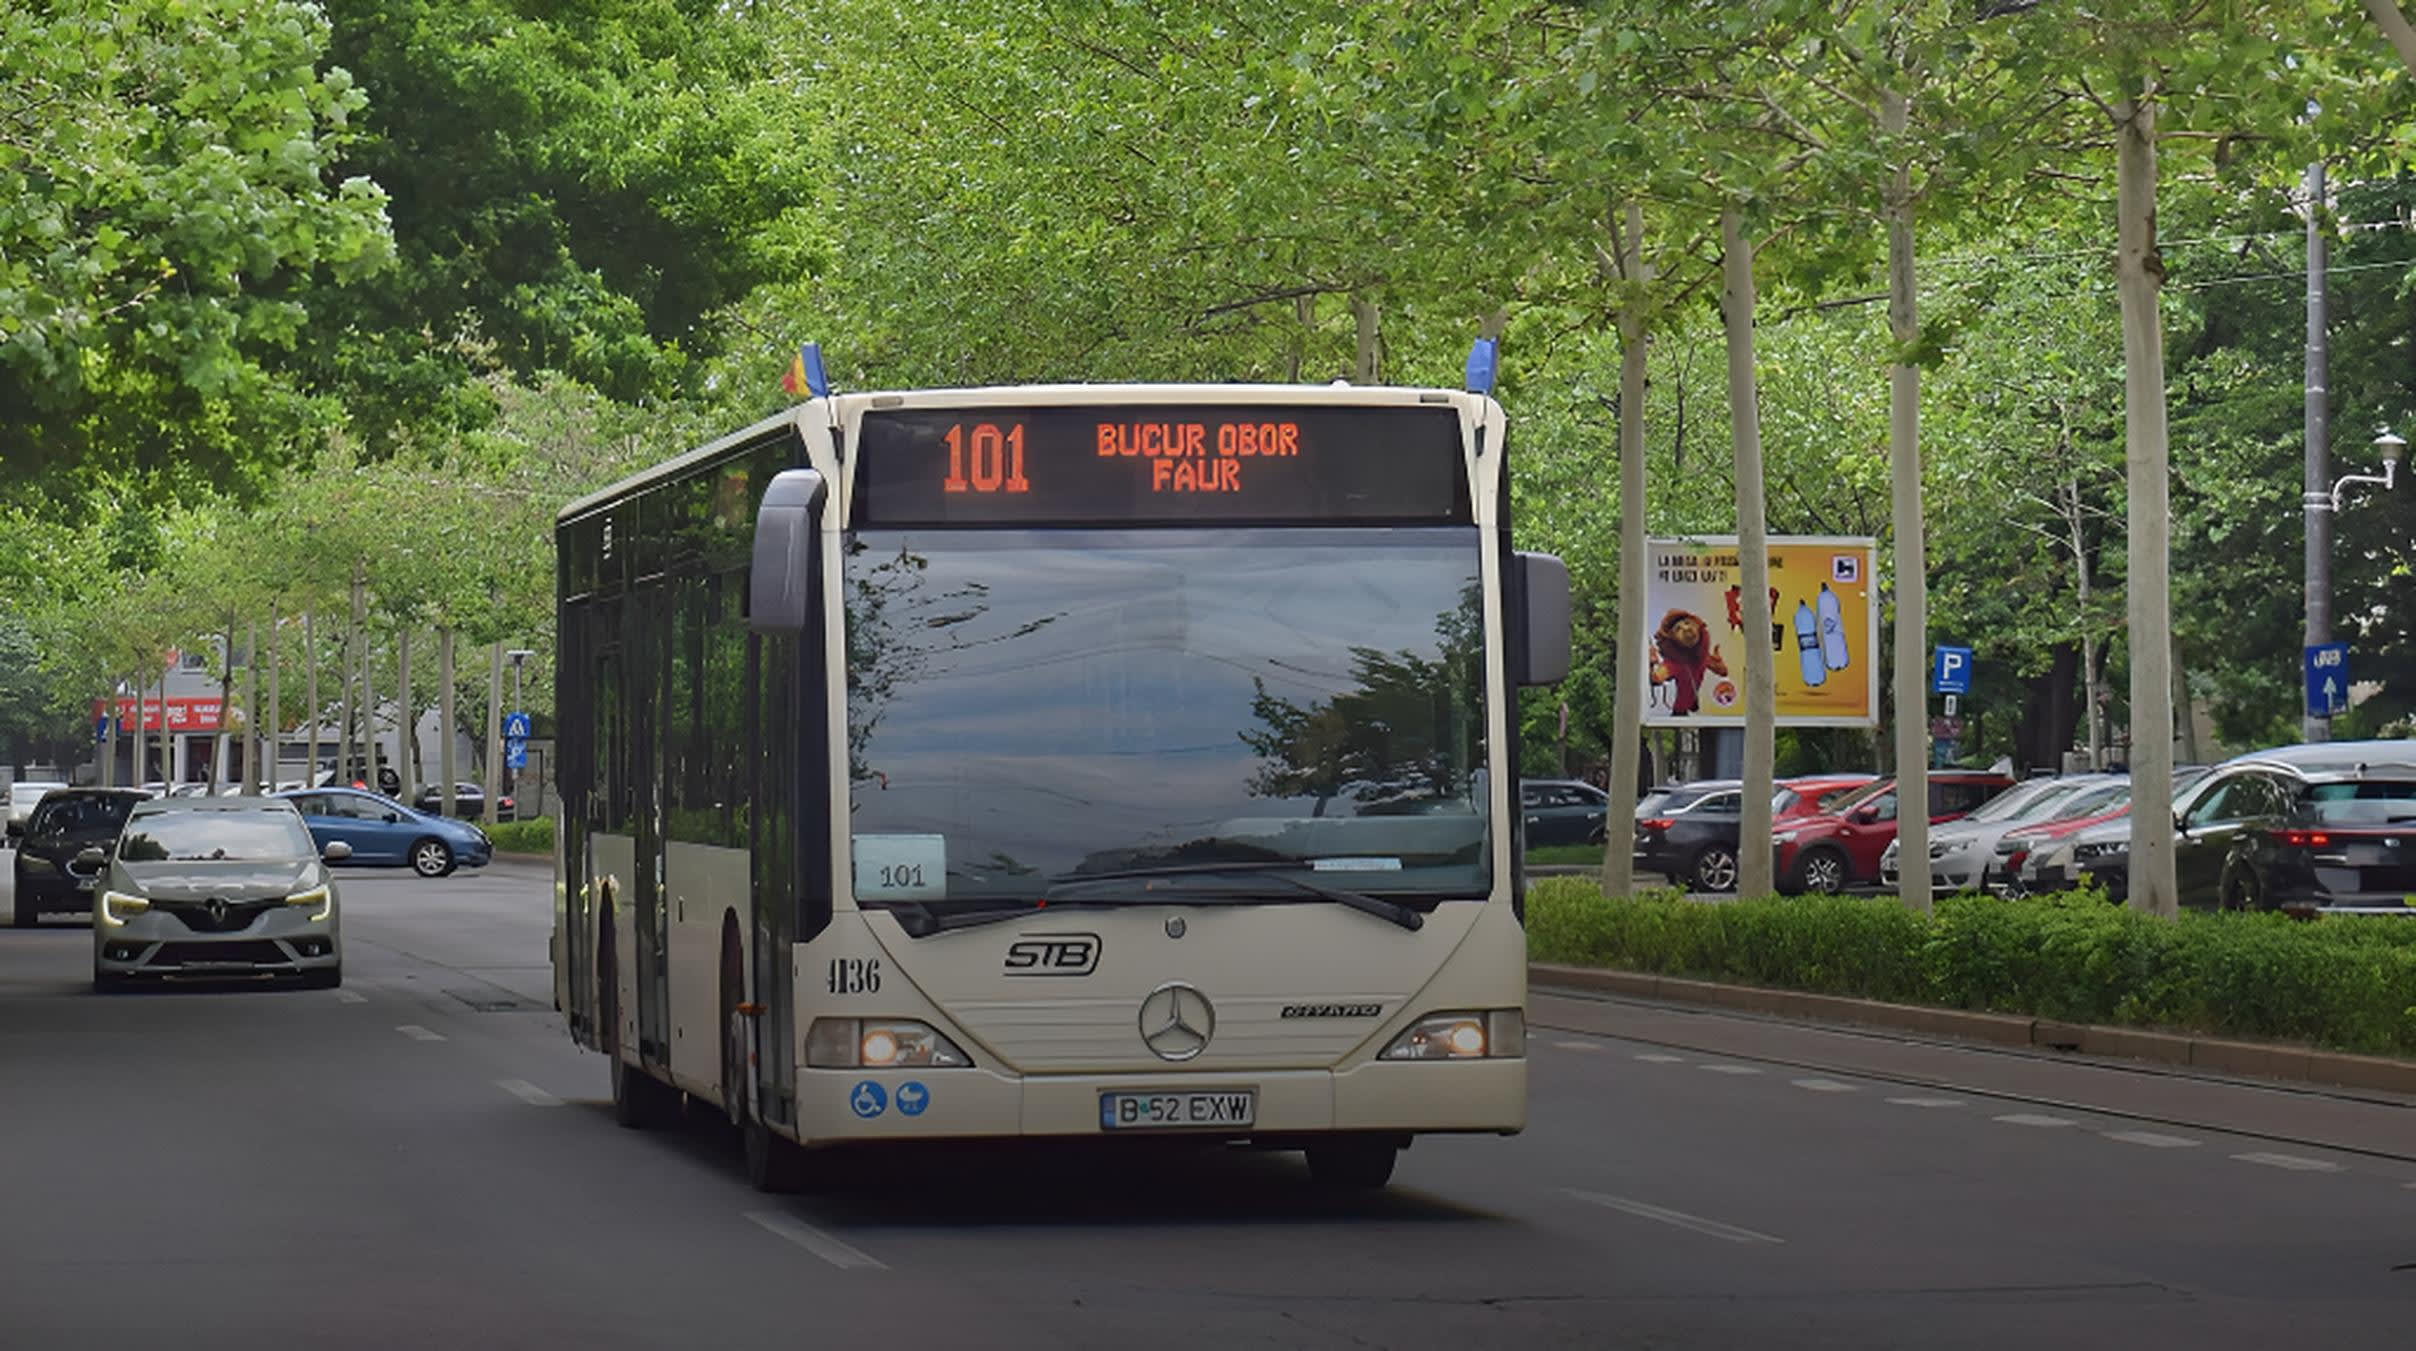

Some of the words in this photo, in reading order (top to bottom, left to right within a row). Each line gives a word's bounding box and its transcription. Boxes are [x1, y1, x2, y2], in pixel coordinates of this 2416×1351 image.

[1097, 424, 1206, 456] BUCUR
[1218, 424, 1298, 456] OBOR
[944, 424, 1029, 492] 101
[1153, 459, 1241, 492] FAUR
[1943, 653, 1962, 680] P
[880, 864, 926, 888] 101
[1005, 942, 1092, 967] STB
[1120, 1098, 1138, 1122] B
[1149, 1098, 1180, 1122] 52
[1190, 1096, 1247, 1121] EXW
